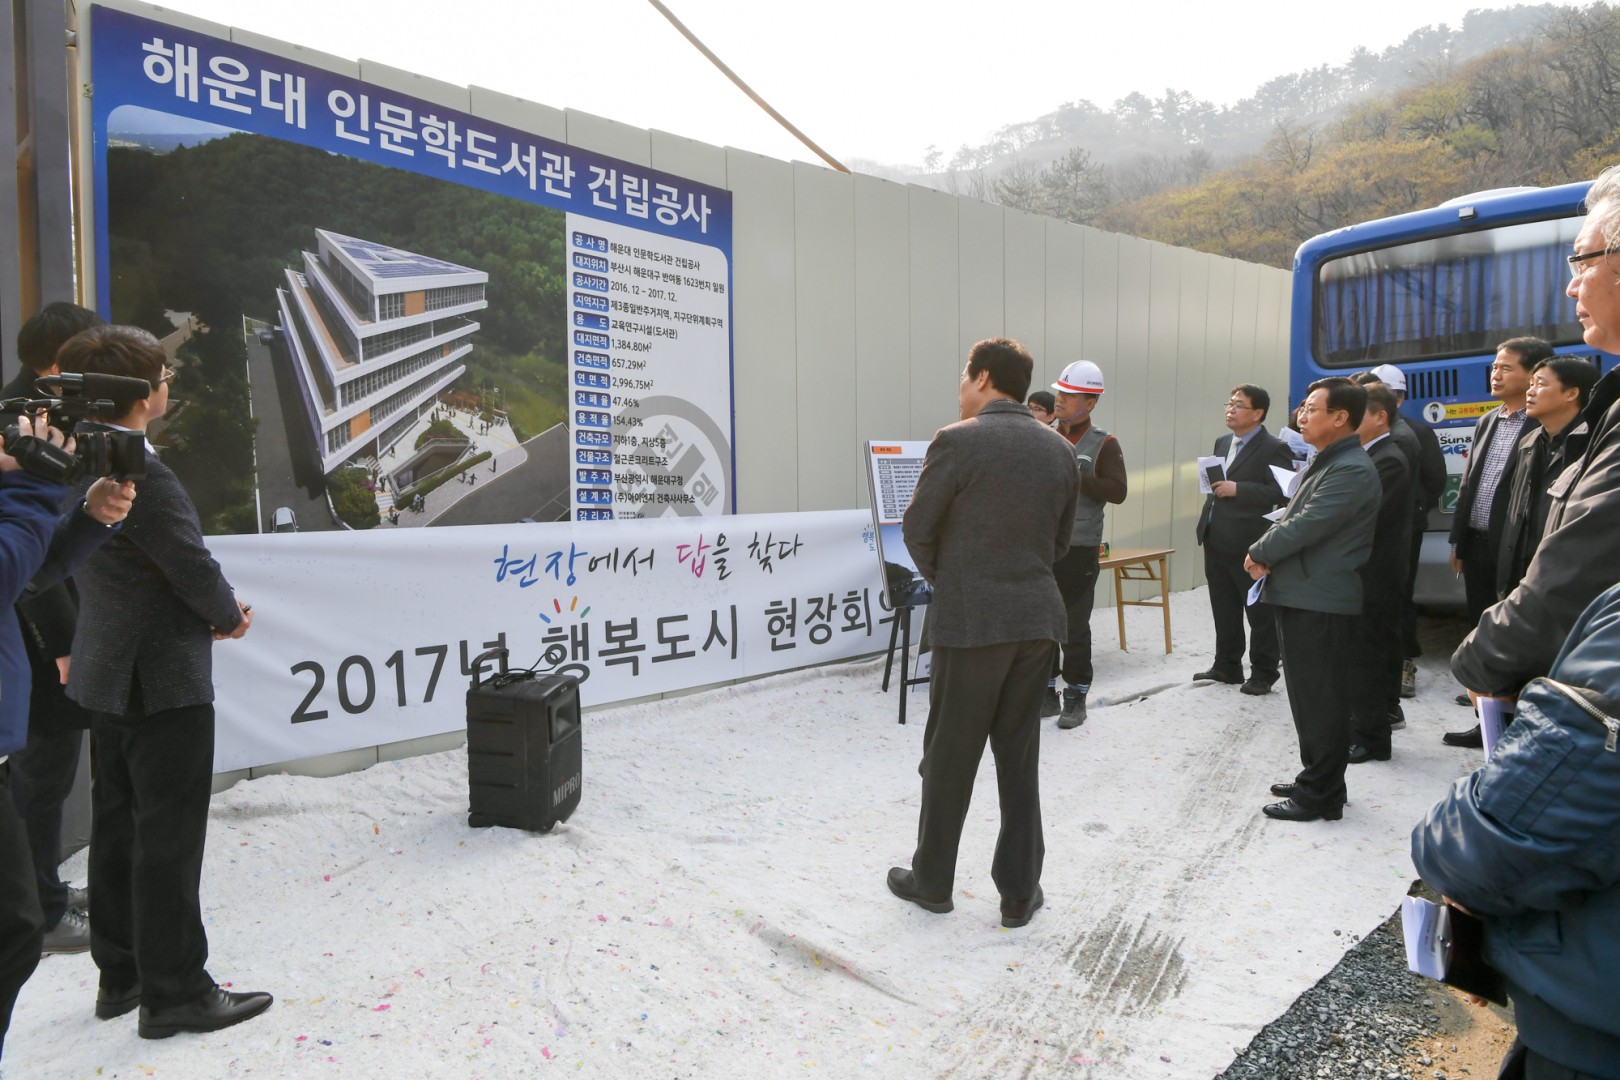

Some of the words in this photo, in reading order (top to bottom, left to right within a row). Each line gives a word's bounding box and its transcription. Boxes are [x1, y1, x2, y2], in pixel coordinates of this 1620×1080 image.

[142, 37, 306, 130] 해운대
[327, 89, 576, 199] 인문학도서관
[587, 164, 712, 234] 건립공사
[575, 254, 607, 272] 대지위치
[610, 242, 631, 256] 해운대
[633, 247, 674, 266] 인문학도서관
[675, 256, 700, 271] 건립공사
[575, 273, 607, 291] 공사기간
[610, 261, 632, 276] 부산시
[633, 266, 661, 281] 해운대구
[662, 273, 682, 286] 반여동
[683, 277, 711, 292] 1623번지
[712, 283, 725, 294] 일원
[611, 281, 630, 294] 2016.
[648, 288, 666, 300] 2017.
[576, 294, 607, 311] 지역지구
[611, 300, 672, 321] 제3종일반주거지역,
[673, 311, 724, 329] 지구단위계획구역
[611, 319, 678, 340] 교육연구시설(도서관)
[576, 332, 607, 348] 대지면적
[577, 352, 608, 368] 건축면적
[612, 396, 640, 408] 47.46%
[613, 415, 644, 428] 154.43%
[578, 432, 610, 444] 건축규모
[613, 434, 640, 448] 지하1층,
[641, 436, 667, 449] 지상5층
[578, 450, 610, 463] 건물구조
[613, 453, 669, 467] 철근콘크리트구조
[614, 472, 649, 485] 부산광역시
[650, 473, 683, 486] 해운대구청
[657, 494, 696, 505] 건축사사무소
[493, 542, 655, 588] 현장에서
[676, 533, 731, 581] 답을
[747, 531, 804, 574] 찾다
[541, 604, 740, 687] 행복도시
[553, 772, 580, 807] MIPRO
